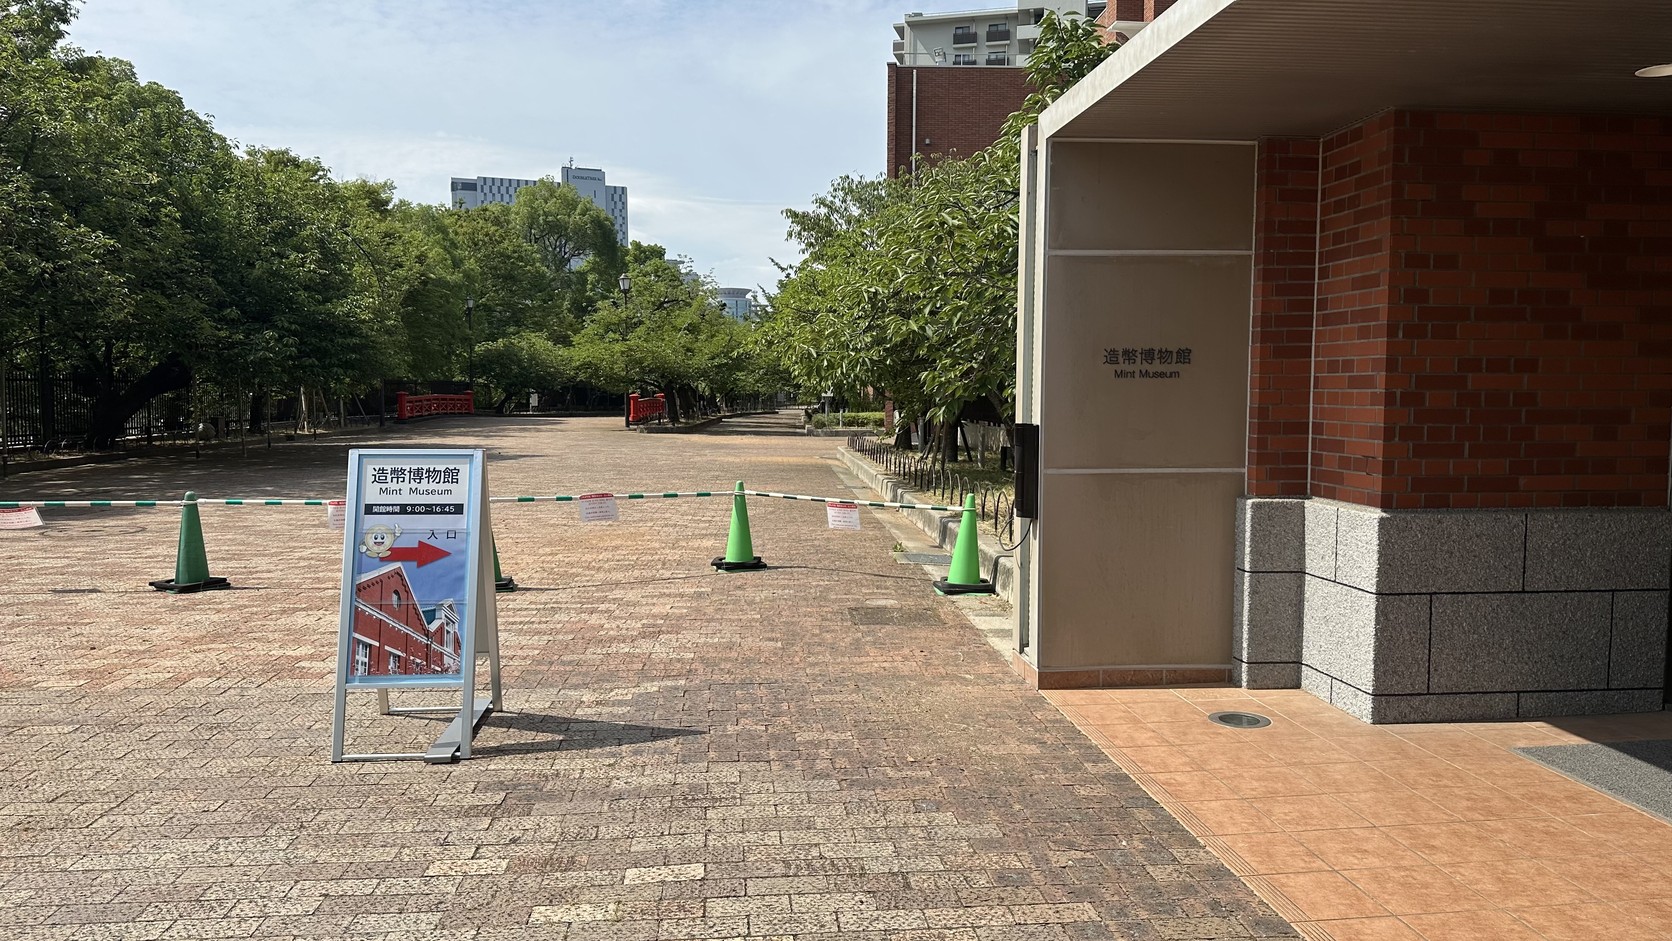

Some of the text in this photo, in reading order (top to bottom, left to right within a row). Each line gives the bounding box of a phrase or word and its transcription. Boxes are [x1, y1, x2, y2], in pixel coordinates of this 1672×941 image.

[1103, 347, 1192, 365] 造幣博物館
[1114, 369, 1180, 379] Mint Museum
[371, 466, 460, 485] 造幣博物館
[379, 487, 453, 496] Mint Museum
[372, 505, 400, 513] 開館時間
